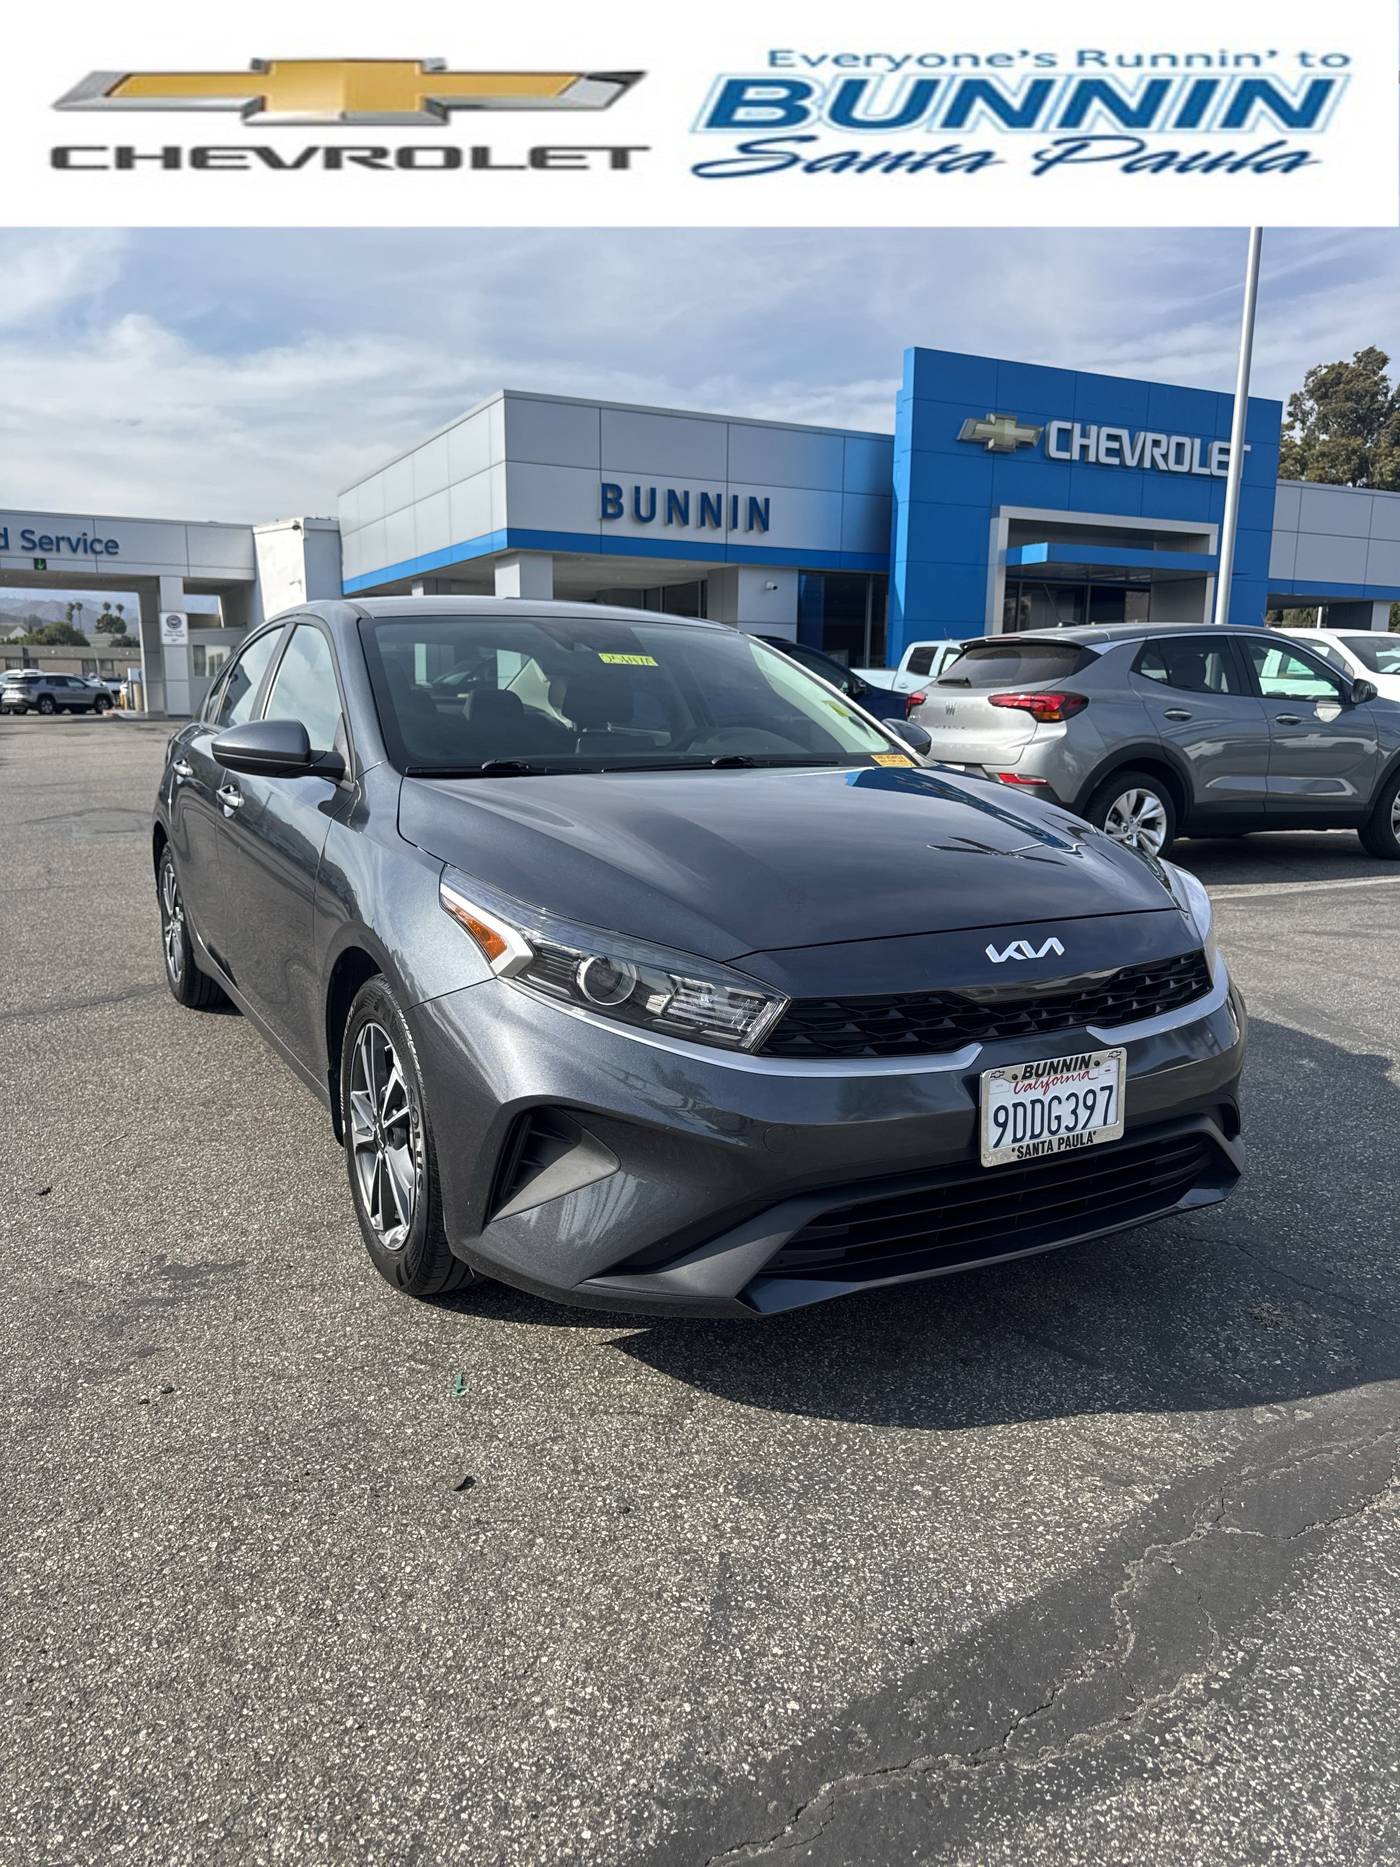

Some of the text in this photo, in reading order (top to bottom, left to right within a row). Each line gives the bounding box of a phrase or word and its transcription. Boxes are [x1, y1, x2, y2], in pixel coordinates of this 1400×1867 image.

[600, 481, 771, 533] BUNNIN
[20, 528, 120, 556] Service
[985, 936, 1065, 964] KIA
[1021, 1054, 1093, 1081] BUNNIN
[1013, 1069, 1099, 1097] California
[993, 1085, 1114, 1149] 9DDG397
[1016, 1131, 1093, 1160] SANTA PAULA
